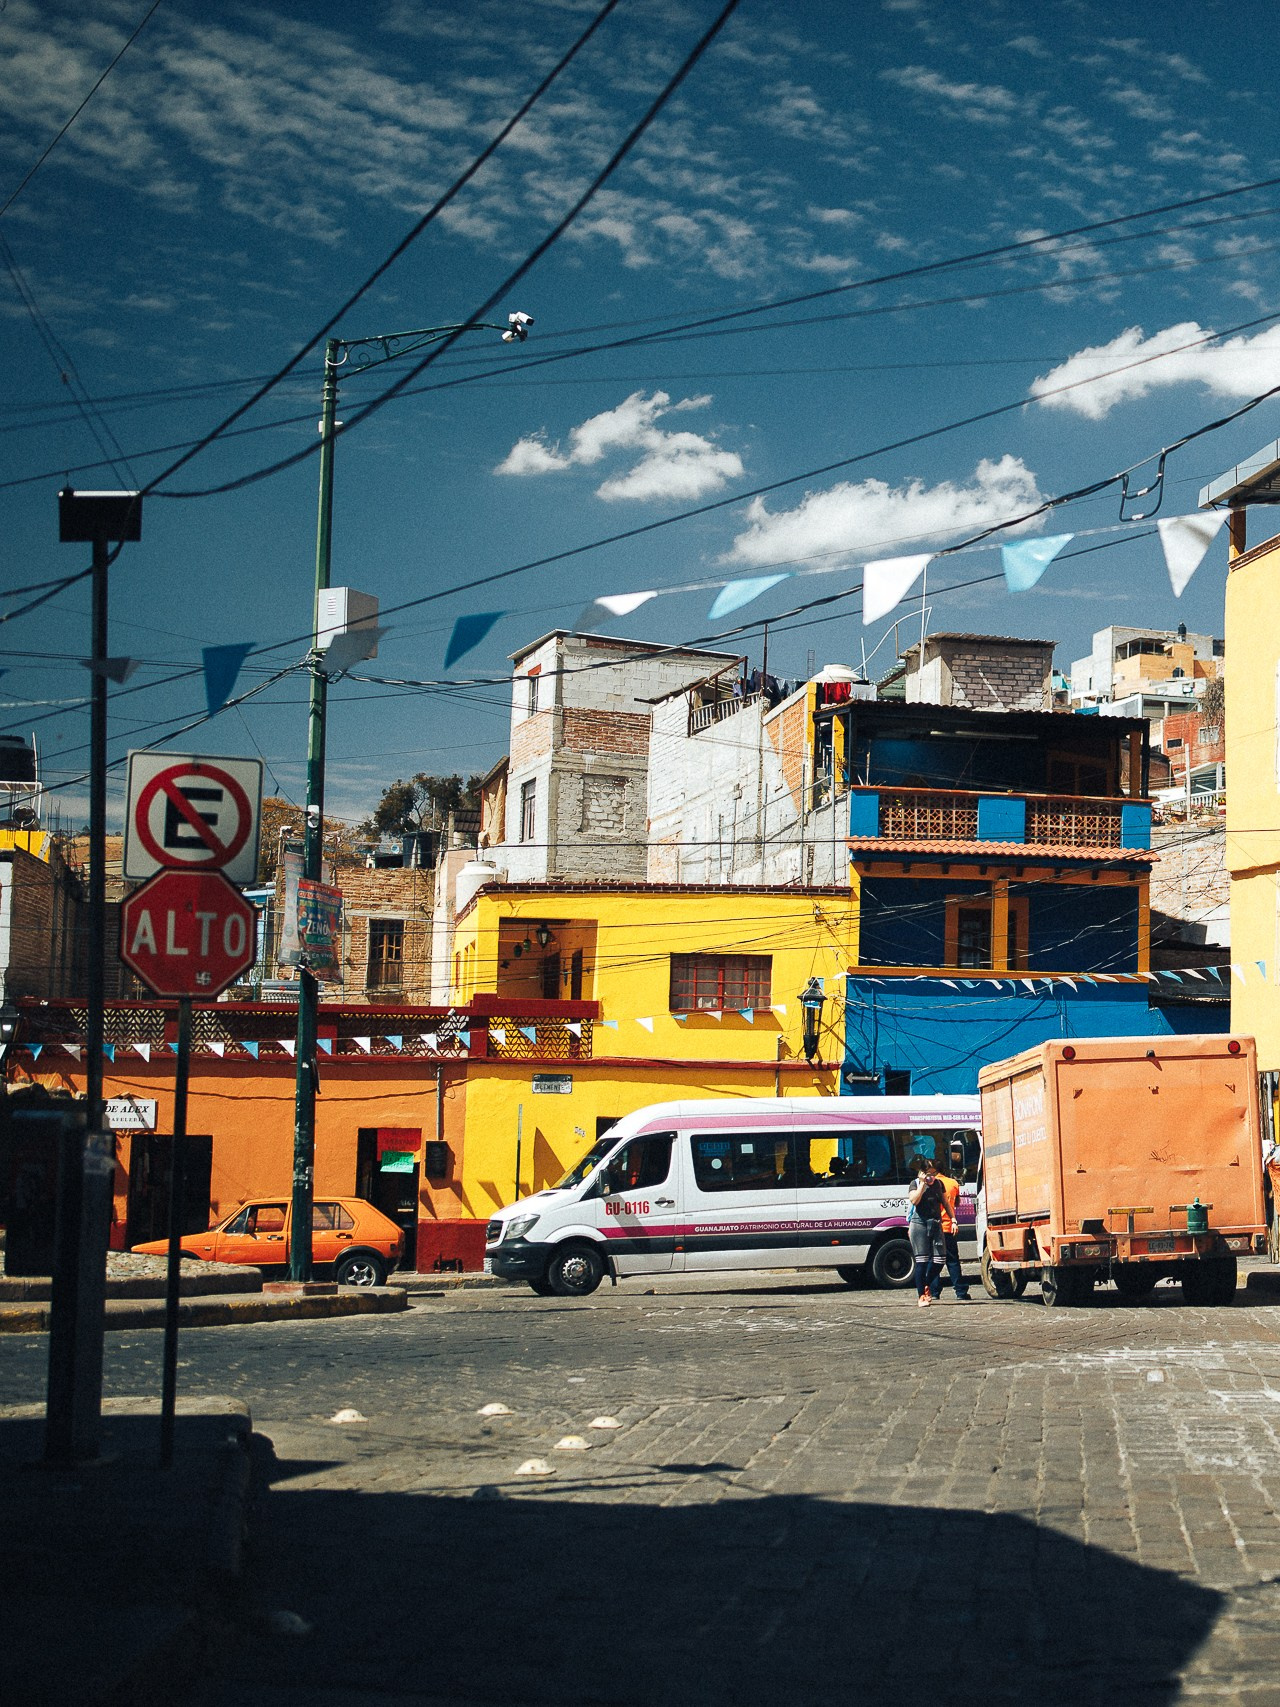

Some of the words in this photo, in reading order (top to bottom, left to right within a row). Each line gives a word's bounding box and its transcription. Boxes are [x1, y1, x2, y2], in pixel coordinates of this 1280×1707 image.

[131, 909, 246, 958] ALTO
[120, 1105, 150, 1113] ALEX
[605, 1201, 650, 1216] GU-0116
[694, 1224, 739, 1232] GUANAJUATO
[740, 1222, 780, 1231] PATRIMONIO
[780, 1221, 813, 1230] CULTURAL
[833, 1220, 872, 1228] HUMANIDAD
